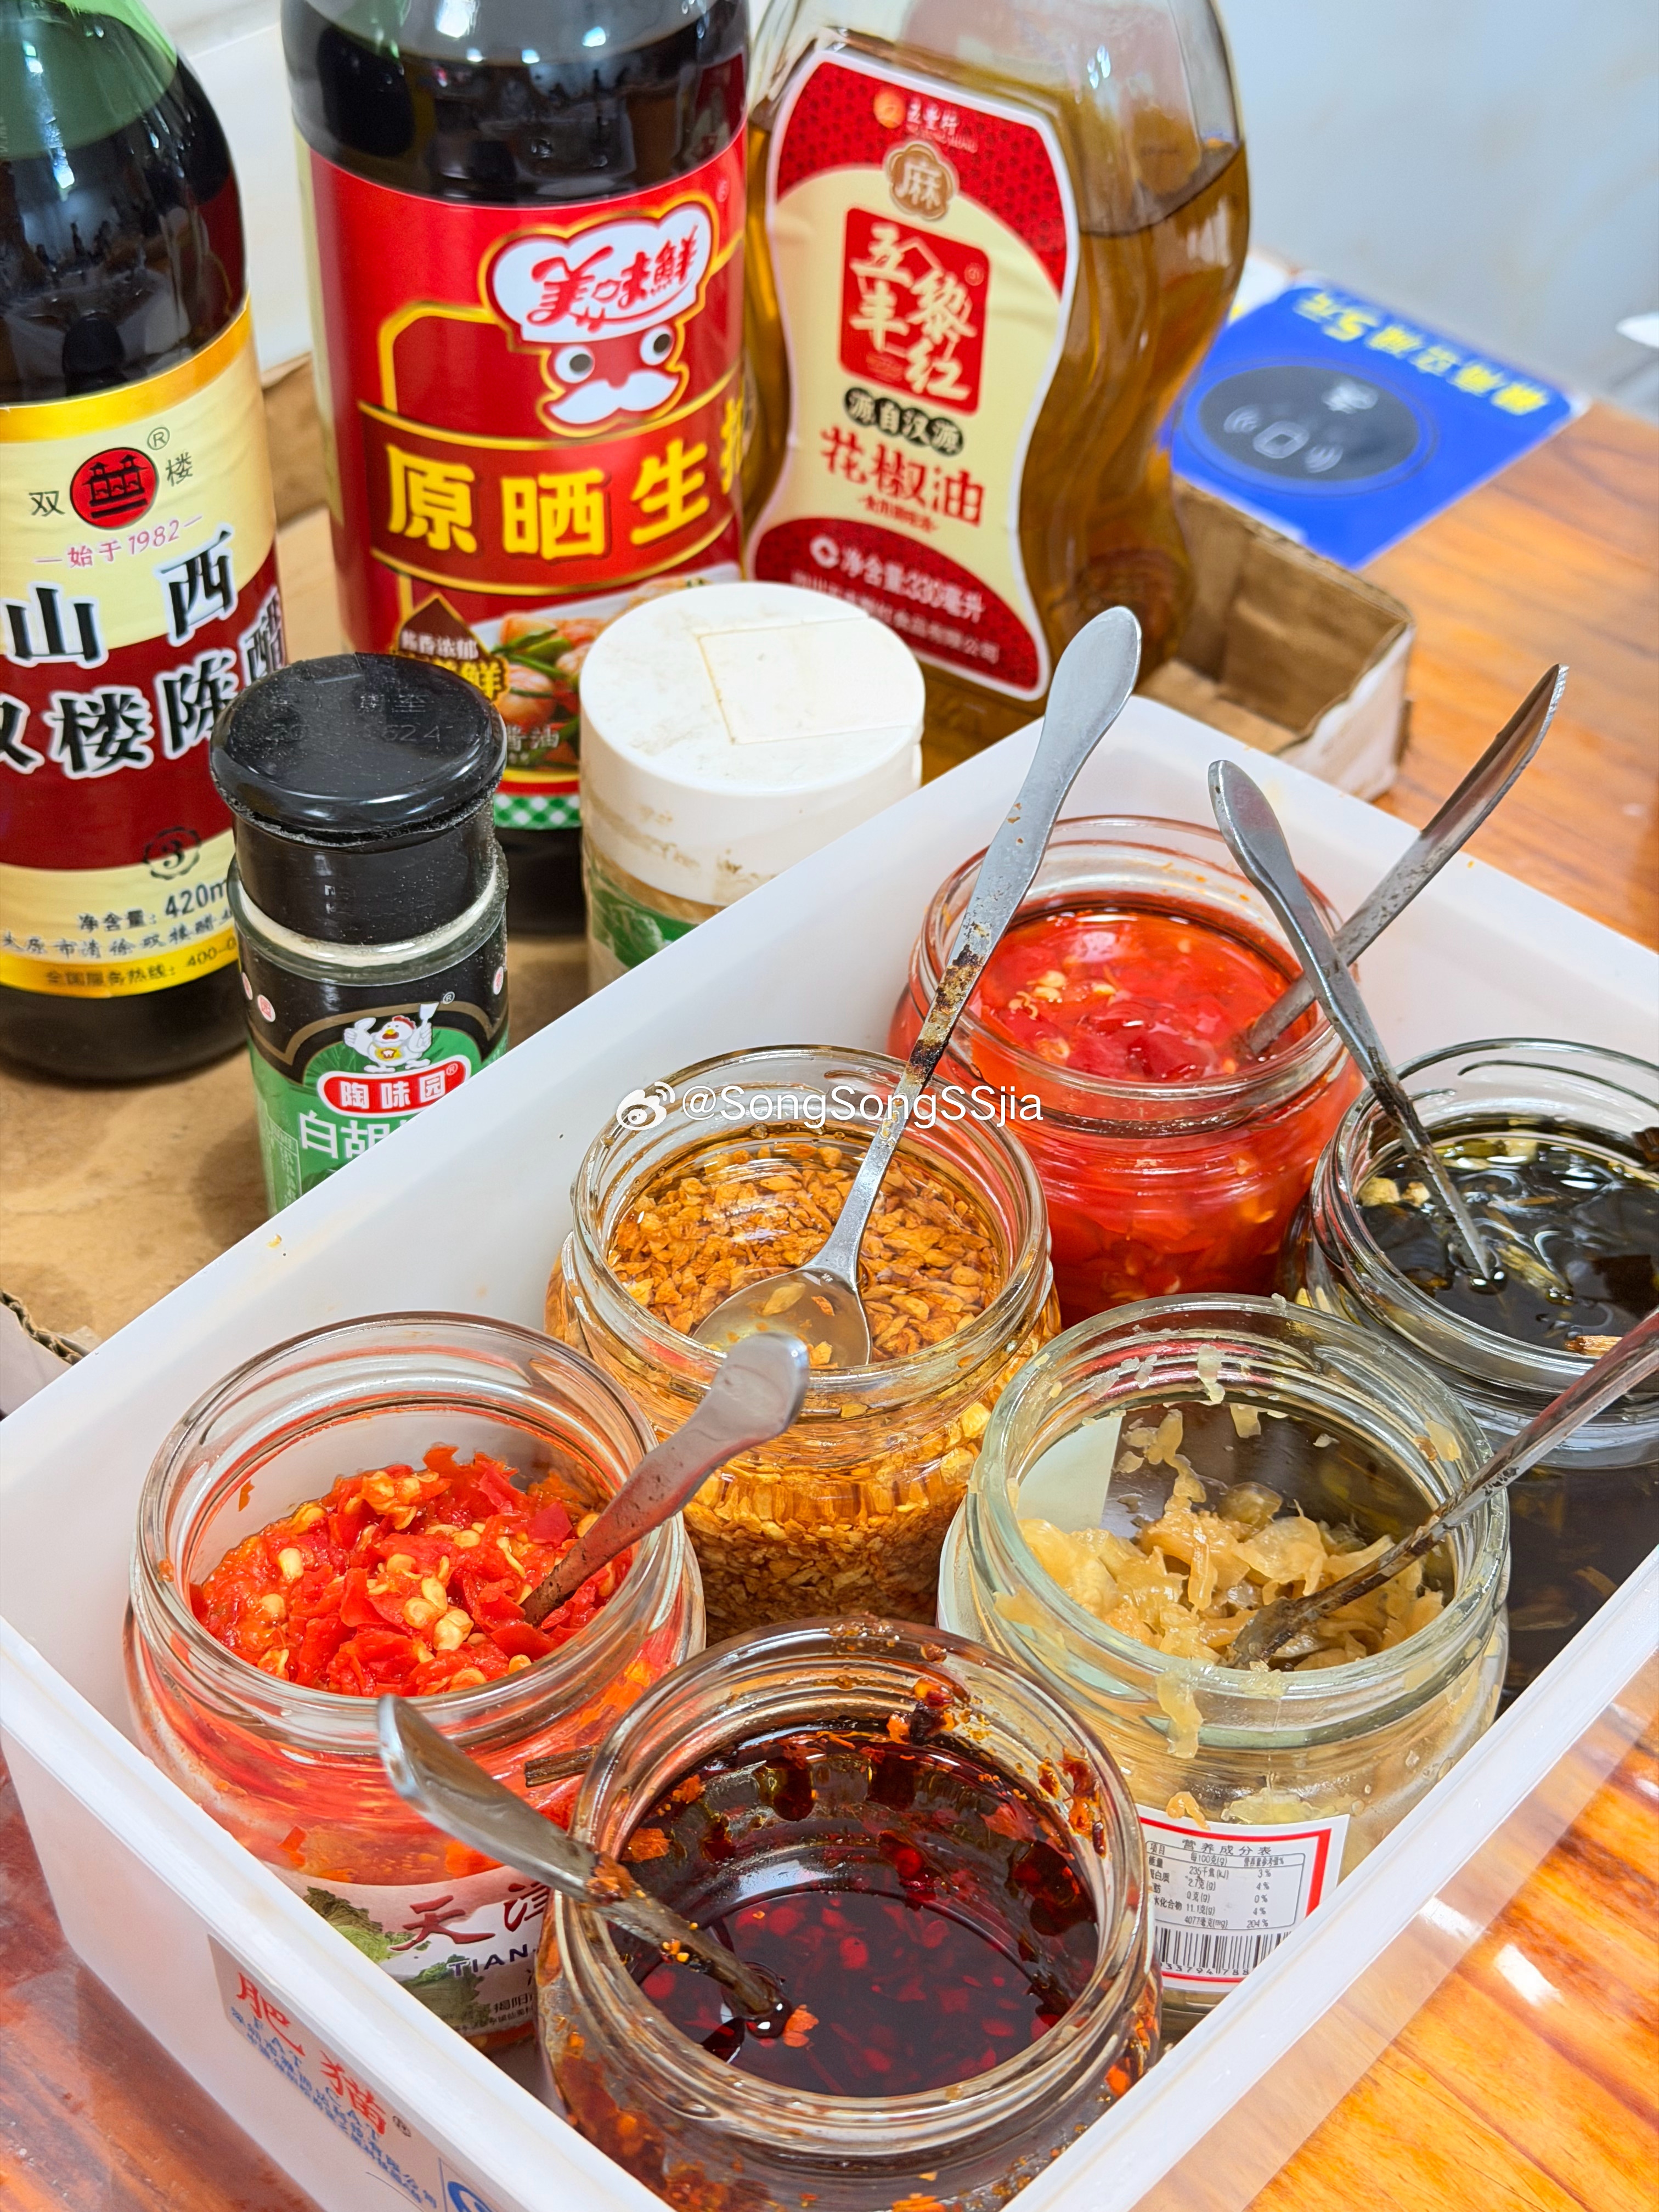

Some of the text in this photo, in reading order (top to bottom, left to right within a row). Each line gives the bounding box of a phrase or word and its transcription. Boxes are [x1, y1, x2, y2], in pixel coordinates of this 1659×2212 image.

[896, 159, 944, 212] 麻
[165, 451, 194, 487] 楼
[821, 422, 985, 527] 花椒油
[29, 489, 65, 517] 双
[67, 519, 180, 569] 始于1982
[4, 528, 234, 661] 山西
[165, 880, 227, 917] 420m
[187, 936, 236, 967] 400-0
[299, 1110, 392, 1160] 白胡
[1149, 1855, 1163, 1869] 能量
[1150, 1843, 1165, 1855] 项目
[1182, 1839, 1272, 1855] 营养成分表
[1153, 1895, 1183, 1911] 水化合物
[449, 1943, 532, 1977] TIAN
[236, 1972, 386, 2135] 肥猫
